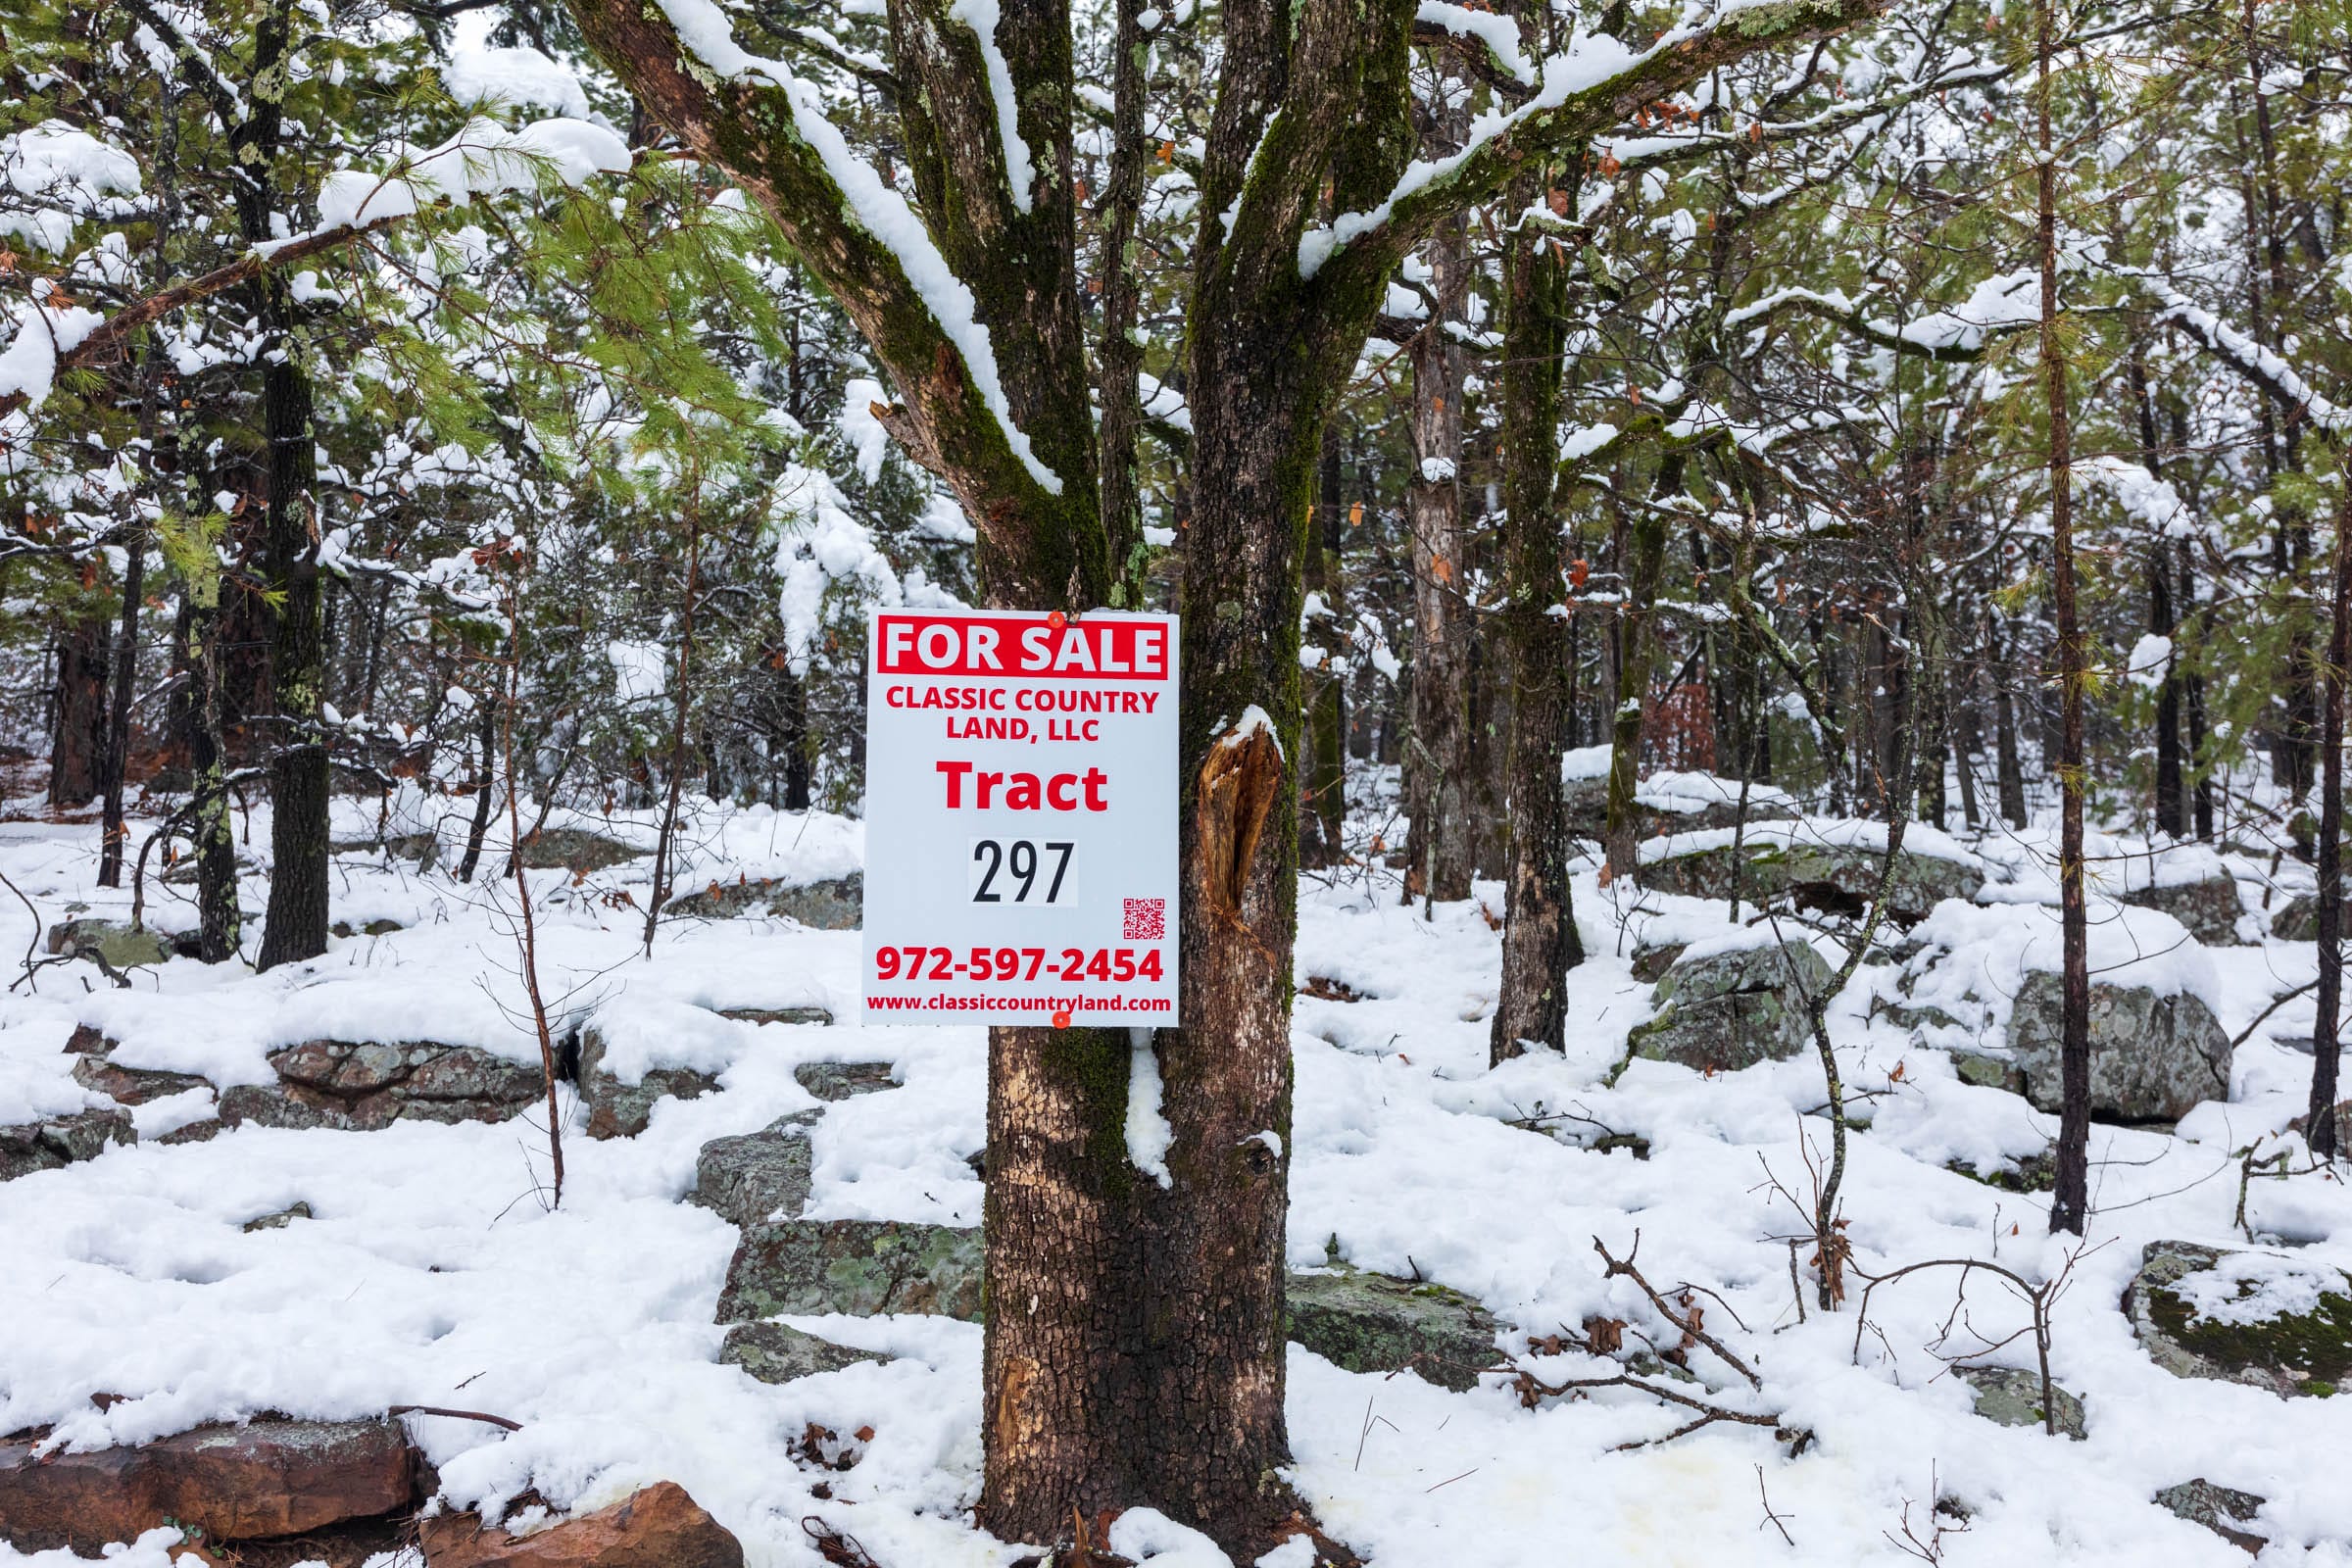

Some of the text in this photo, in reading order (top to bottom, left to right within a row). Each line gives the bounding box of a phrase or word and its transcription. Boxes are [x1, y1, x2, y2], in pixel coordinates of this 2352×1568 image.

[886, 622, 1162, 673] FOR SALE
[886, 685, 1159, 713] CLASSIC COUNTRY
[947, 716, 1100, 745] LAND, LLC
[936, 760, 1108, 811] Tract
[972, 839, 1075, 904] 297
[875, 946, 1164, 982] 972-597-2454
[867, 993, 1171, 1014] www.classiccountryland.com
